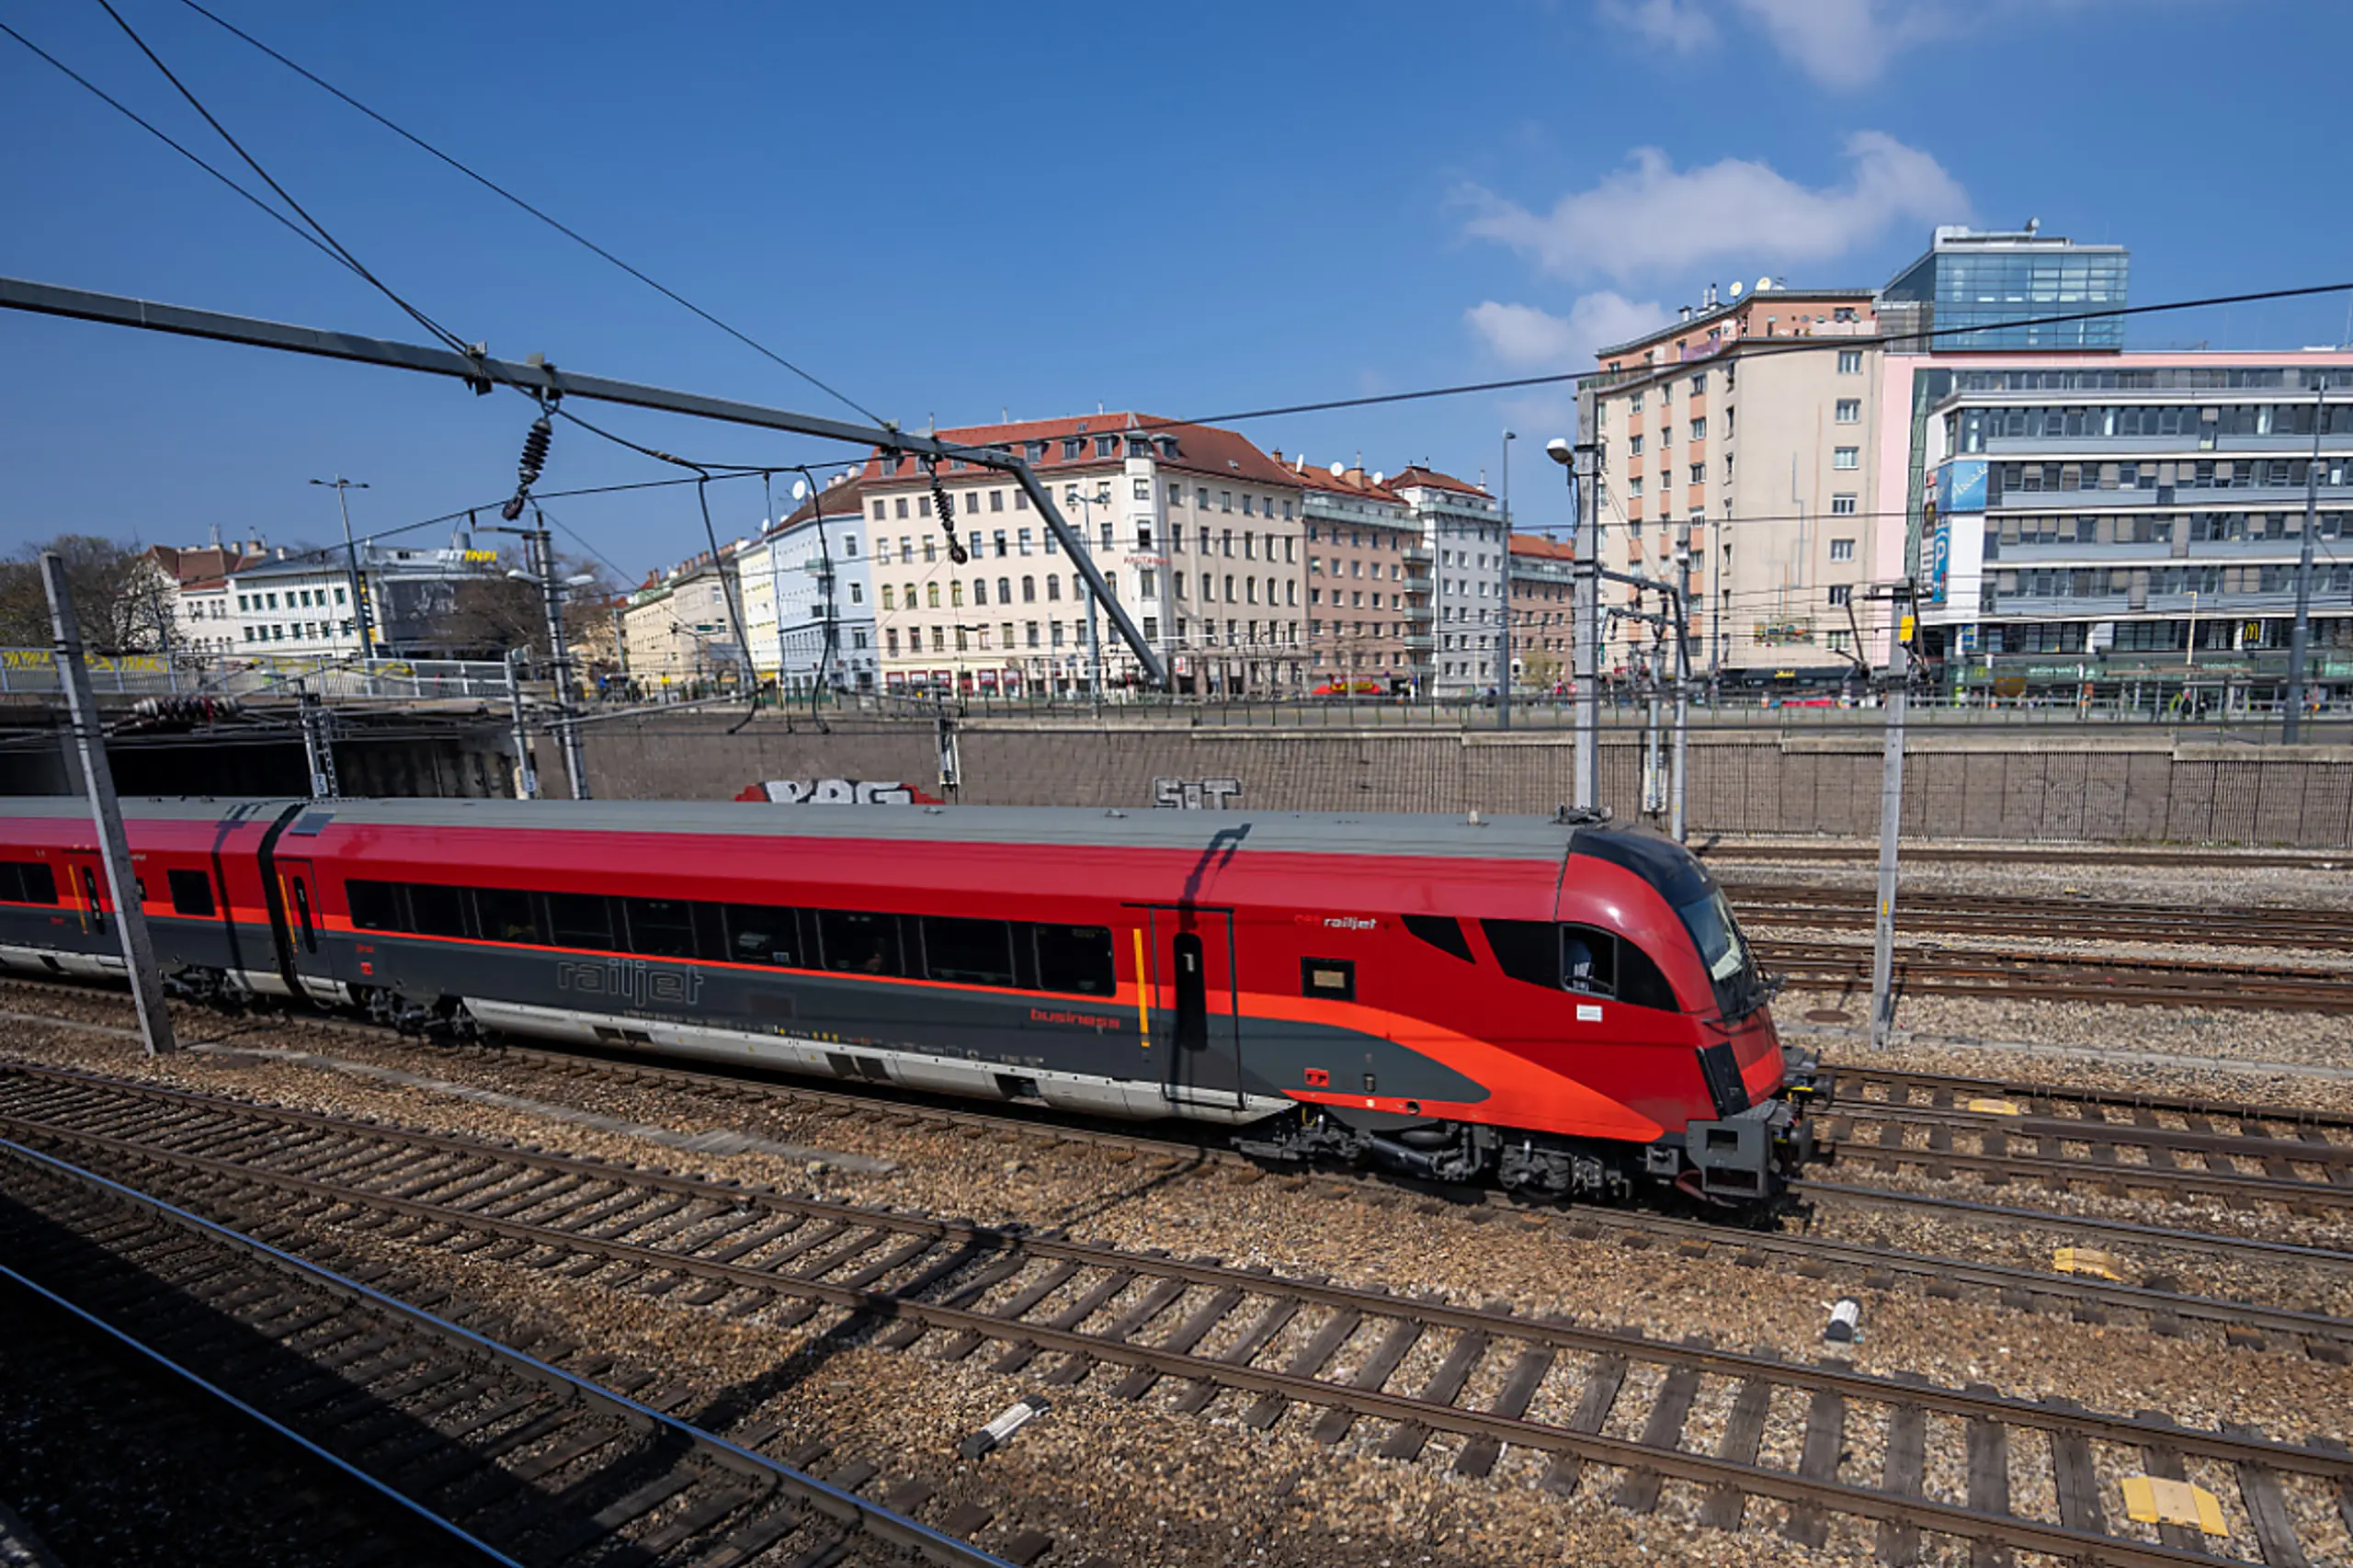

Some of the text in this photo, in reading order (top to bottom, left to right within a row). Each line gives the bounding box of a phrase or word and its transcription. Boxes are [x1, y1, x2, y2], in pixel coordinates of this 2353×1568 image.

[1324, 916, 1377, 930] railjet
[1183, 953, 1194, 971] 1
[558, 959, 704, 1007] railjet
[1030, 1008, 1120, 1029] business
